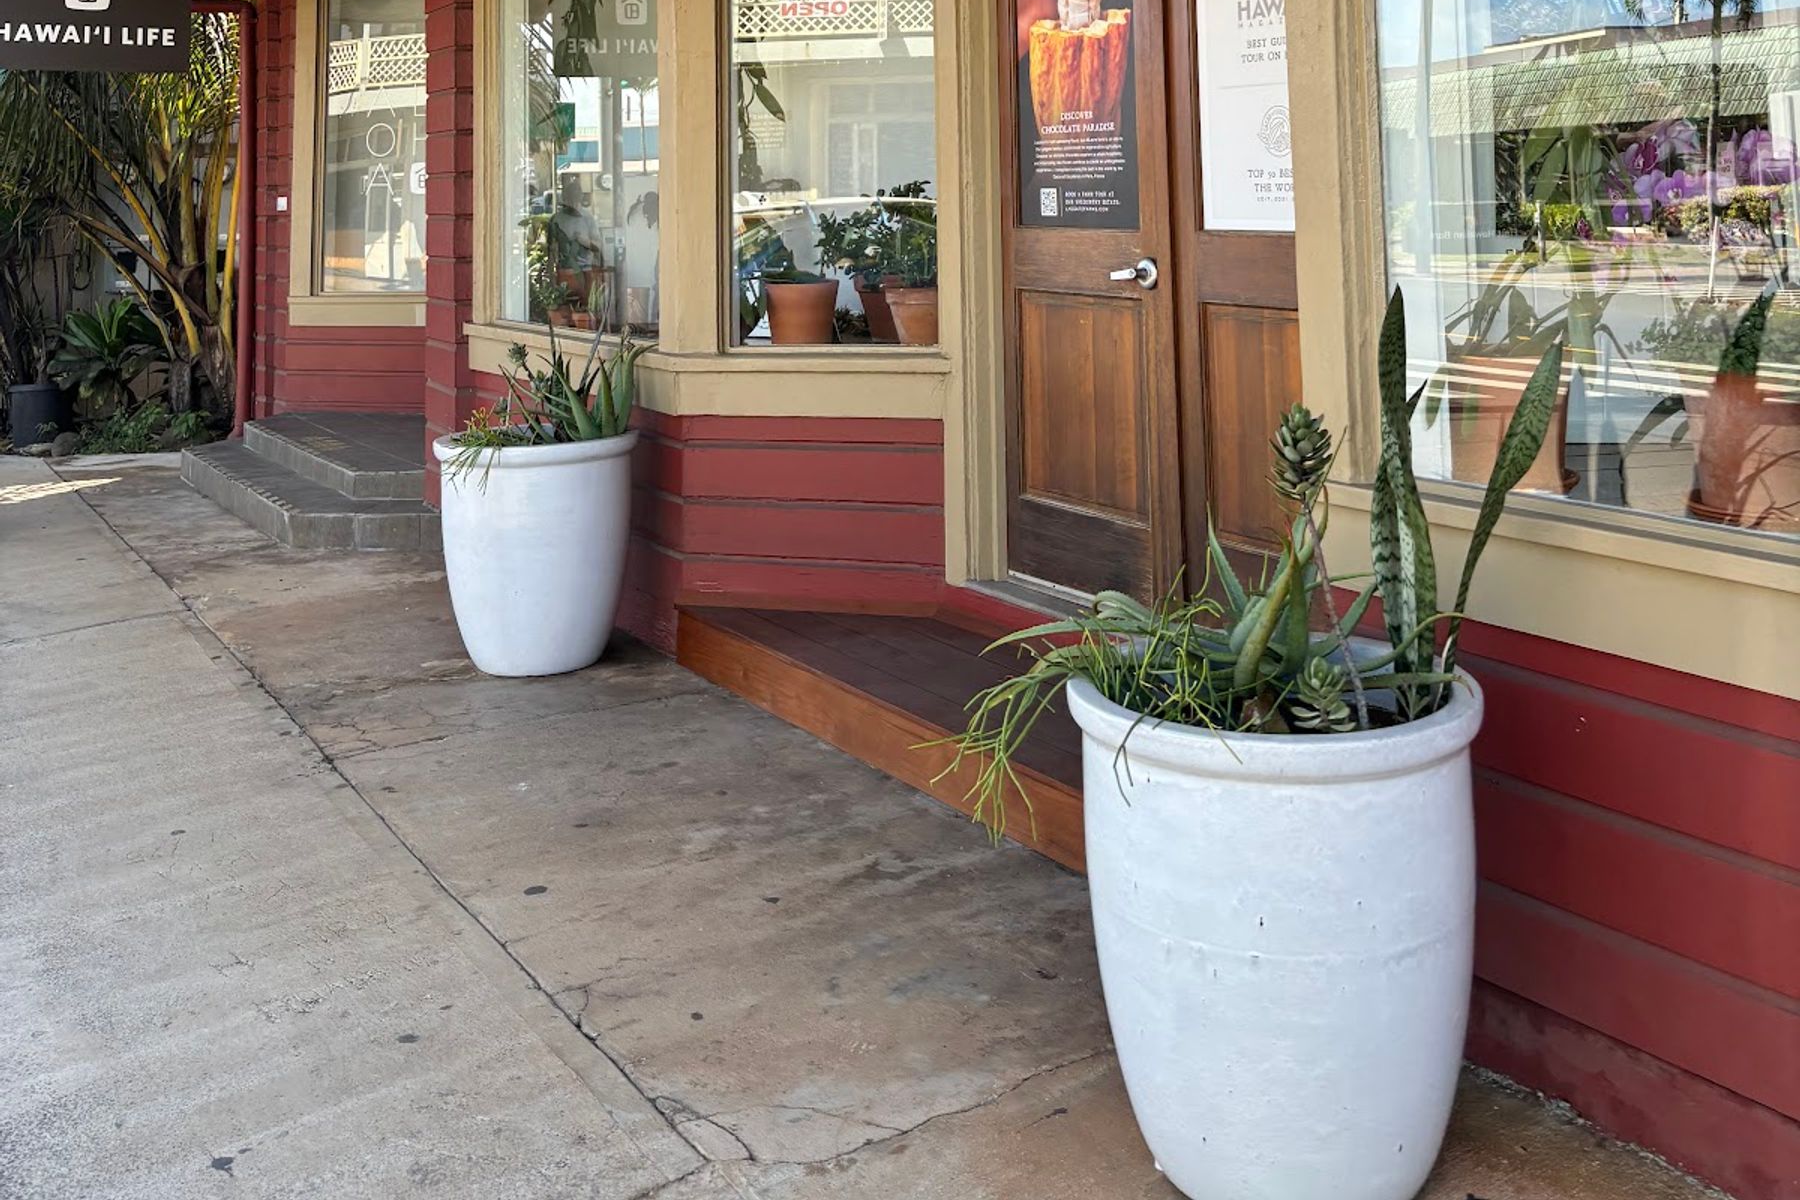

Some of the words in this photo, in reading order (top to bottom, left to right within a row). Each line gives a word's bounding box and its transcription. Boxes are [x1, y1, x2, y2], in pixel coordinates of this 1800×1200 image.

[121, 27, 175, 46] LIFE
[1246, 38, 1267, 49] BEST
[1241, 52, 1265, 64] TOUR
[1267, 50, 1281, 61] ON
[1060, 111, 1094, 121] DISCOVER
[1041, 124, 1081, 135] CHOCOLATE
[1082, 122, 1116, 133] PARADISE
[1247, 169, 1264, 179] TOP
[1254, 182, 1272, 193] THE
